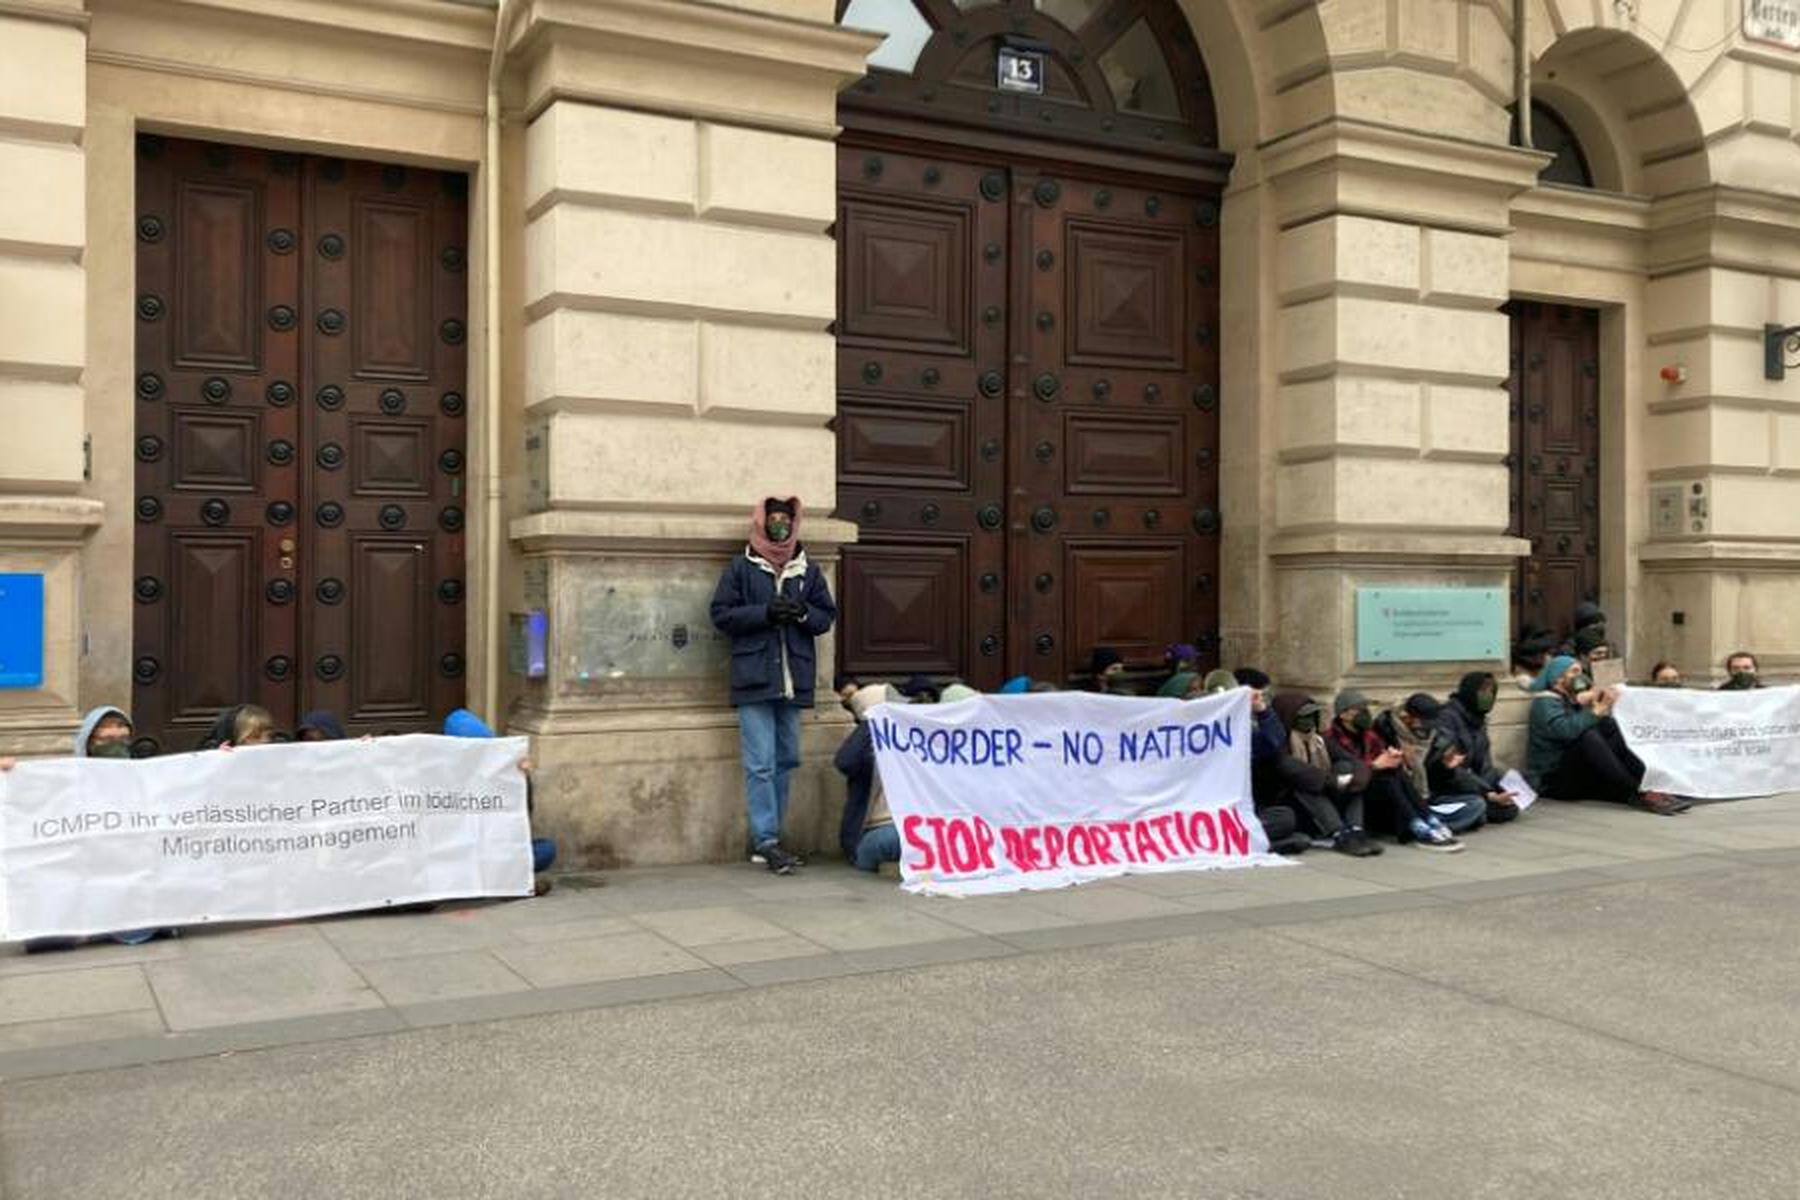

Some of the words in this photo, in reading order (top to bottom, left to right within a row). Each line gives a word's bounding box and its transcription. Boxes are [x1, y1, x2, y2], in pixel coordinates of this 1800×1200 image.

[1009, 57, 1033, 80] 13
[909, 727, 1024, 766] BORDER
[1062, 731, 1104, 765] NO
[1119, 716, 1233, 762] NATION
[32, 810, 122, 839] ICMPD
[131, 811, 158, 829] ihr
[169, 803, 304, 826] verlässlicher
[311, 794, 394, 817] Partner
[399, 794, 421, 809] im
[426, 791, 504, 810] tödlichen
[162, 821, 417, 860] Migrationsmanagement
[903, 815, 996, 874] STOP
[1001, 805, 1249, 873] DEPORTATION
